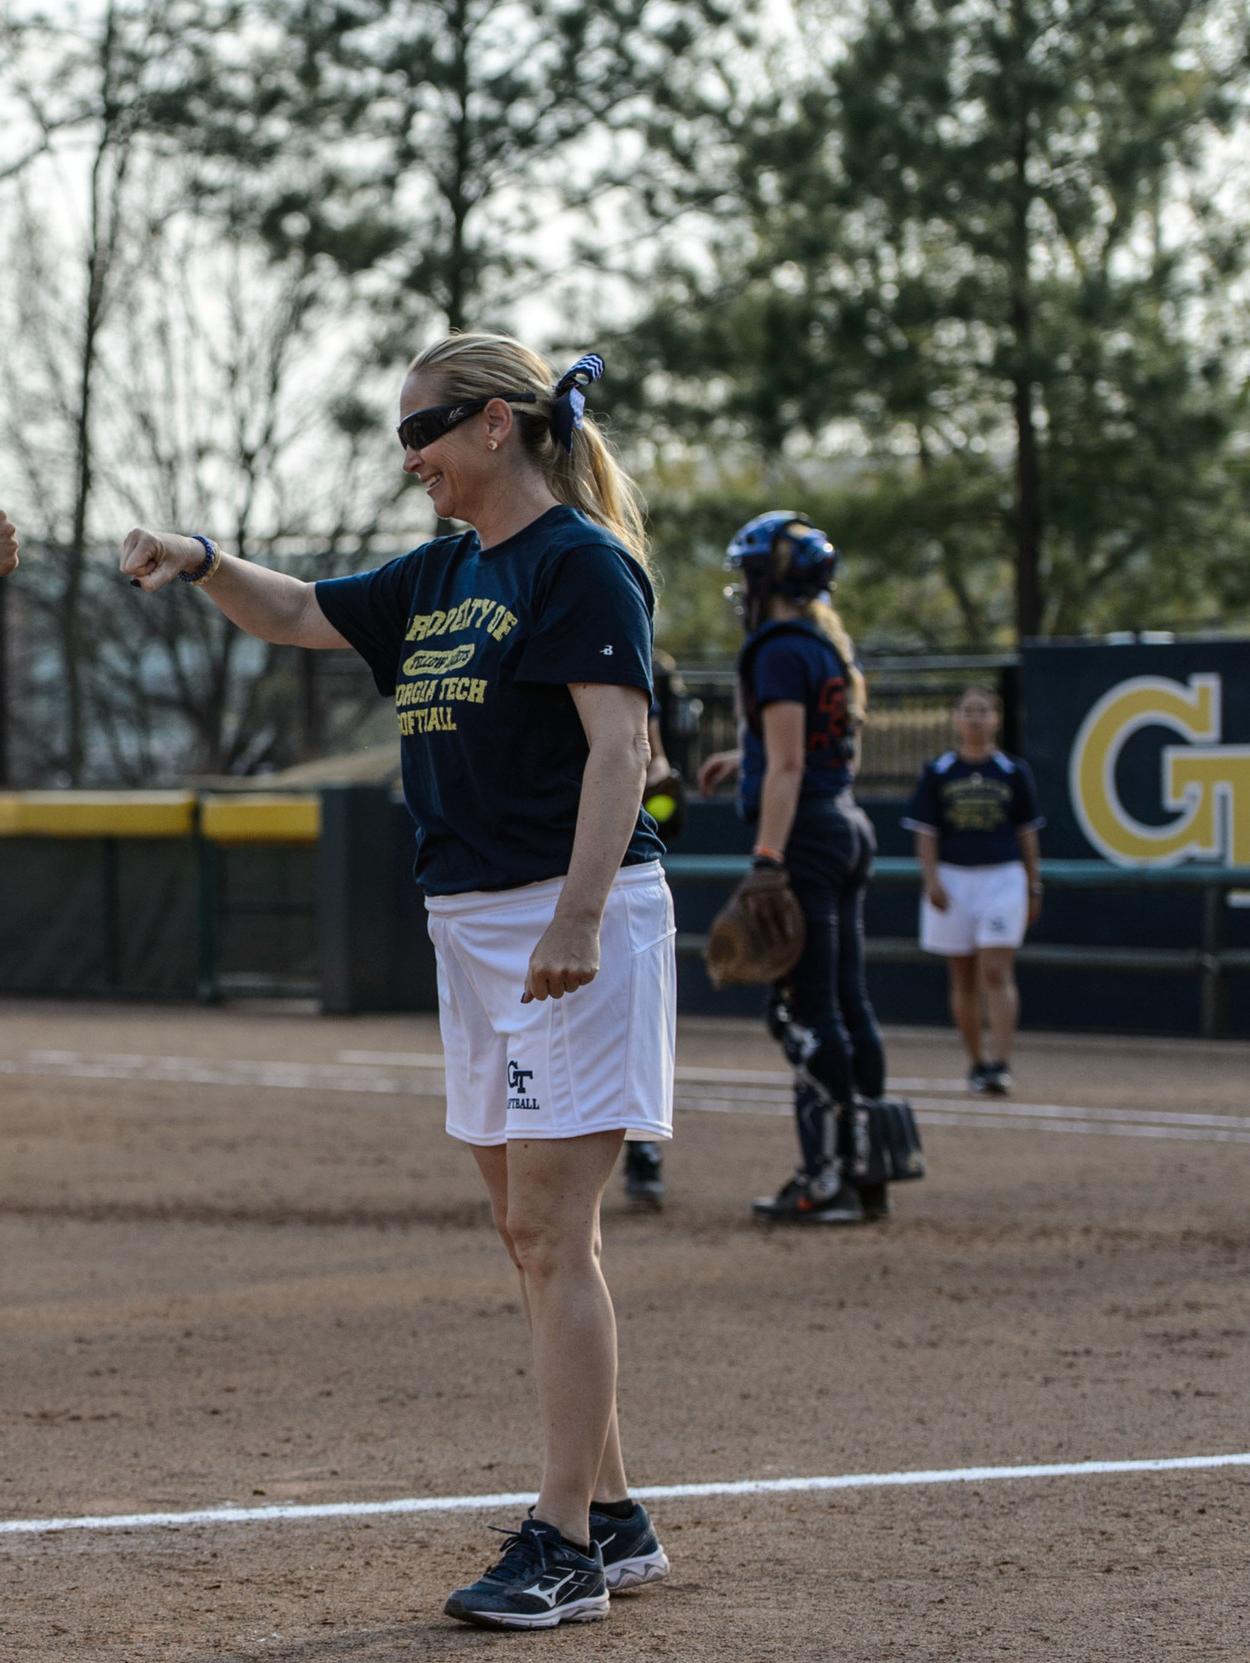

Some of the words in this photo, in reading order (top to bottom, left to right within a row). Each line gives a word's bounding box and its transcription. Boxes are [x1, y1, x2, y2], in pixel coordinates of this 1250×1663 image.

[405, 598, 497, 641] ROPERTY
[487, 605, 518, 641] OF
[439, 677, 488, 703] TECH
[397, 707, 457, 736] OFTALL
[507, 1060, 533, 1093] GT
